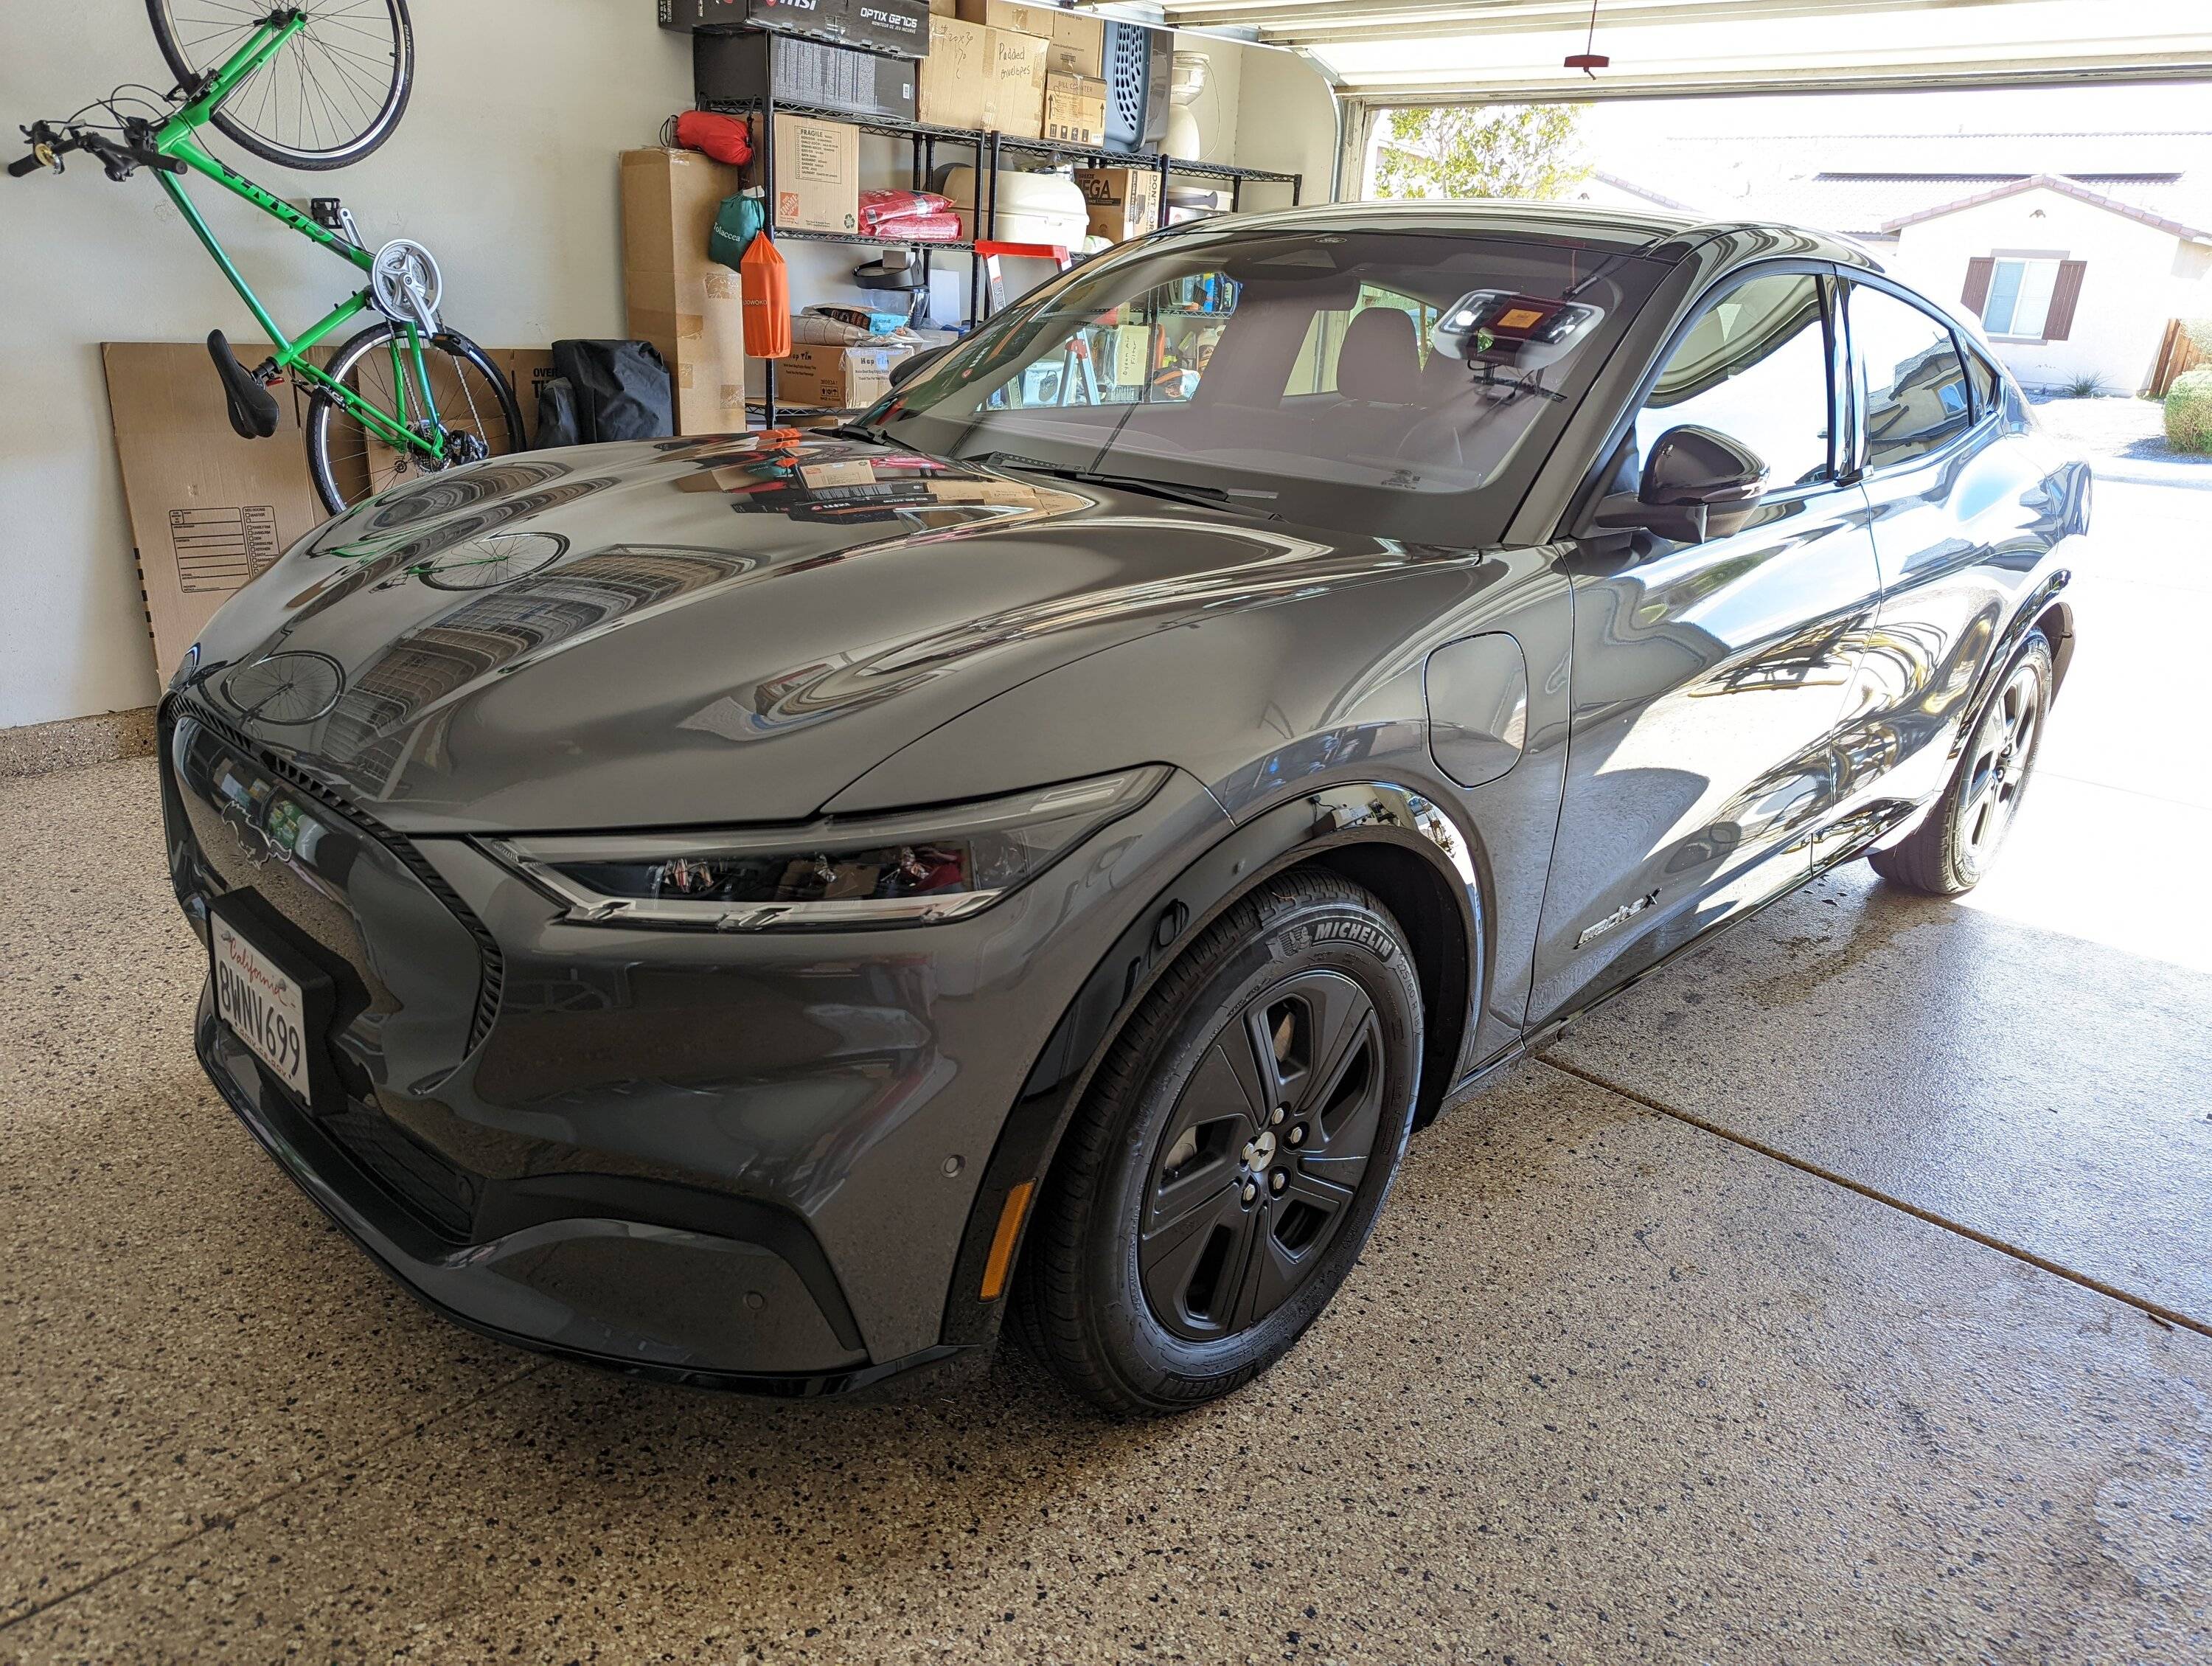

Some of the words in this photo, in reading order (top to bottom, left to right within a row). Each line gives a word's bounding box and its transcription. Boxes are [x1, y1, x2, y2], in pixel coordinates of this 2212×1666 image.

[860, 7, 888, 21] OPTIX
[999, 43, 1025, 60] Padded
[801, 129, 823, 137] FRAGILE
[1079, 179, 1111, 200] EGA
[714, 222, 740, 242] Tolaccea
[1315, 922, 1393, 957] MICHELIN
[229, 938, 287, 1007] California
